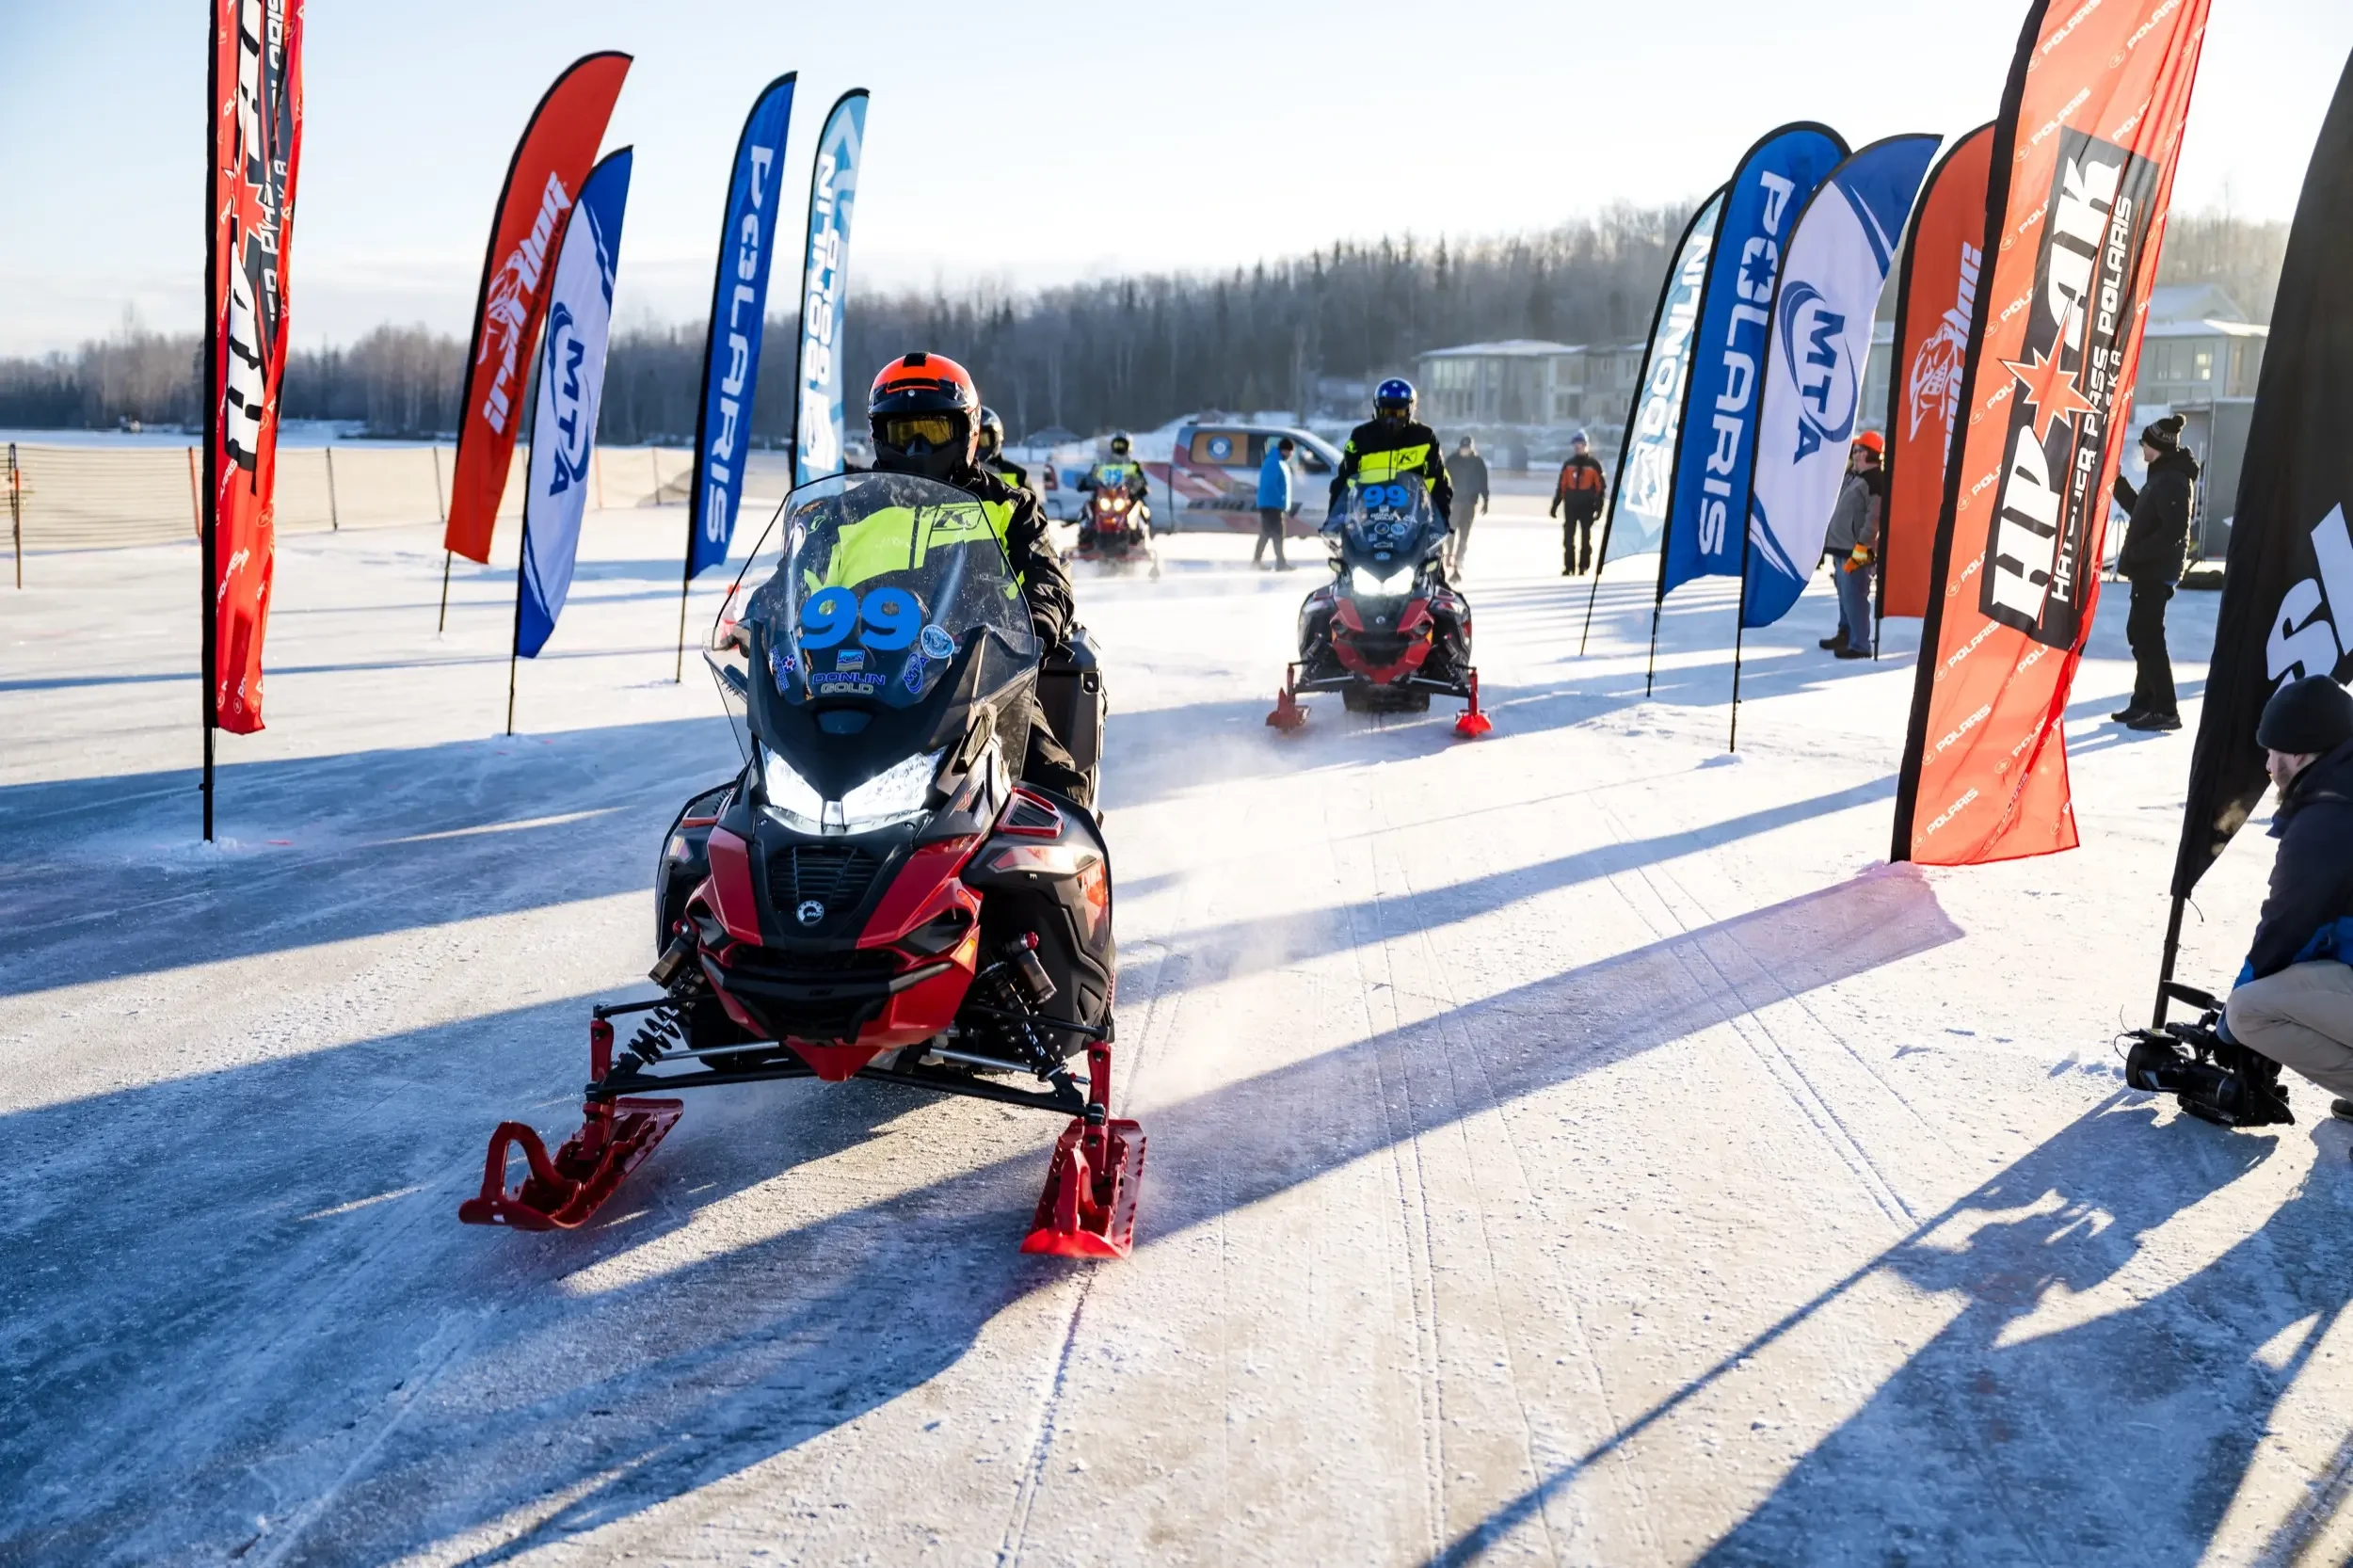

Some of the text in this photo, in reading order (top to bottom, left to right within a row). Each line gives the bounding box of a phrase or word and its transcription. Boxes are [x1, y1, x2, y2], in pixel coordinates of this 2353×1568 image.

[2031, 87, 2091, 146] POLARIS
[804, 152, 837, 383] DONLIN
[816, 228, 840, 386] GOLD
[2048, 156, 2121, 351] AK
[705, 145, 774, 544] POLARIS
[1641, 235, 1713, 437] DONLIN
[1698, 169, 1796, 557] POLARIS
[2084, 345, 2109, 438] PASS
[2097, 195, 2133, 337] POLARIS
[550, 337, 584, 497] MTA
[1793, 309, 1846, 465] MTA
[1363, 485, 1408, 508] 99
[798, 586, 922, 650] 99
[903, 653, 930, 686] MTA
[1947, 619, 2001, 668] POLARIS
[811, 671, 887, 686] DONLIN
[820, 681, 874, 695] GOLD
[1935, 704, 1992, 753] POLARIS
[1926, 787, 1978, 835] POLARIS
